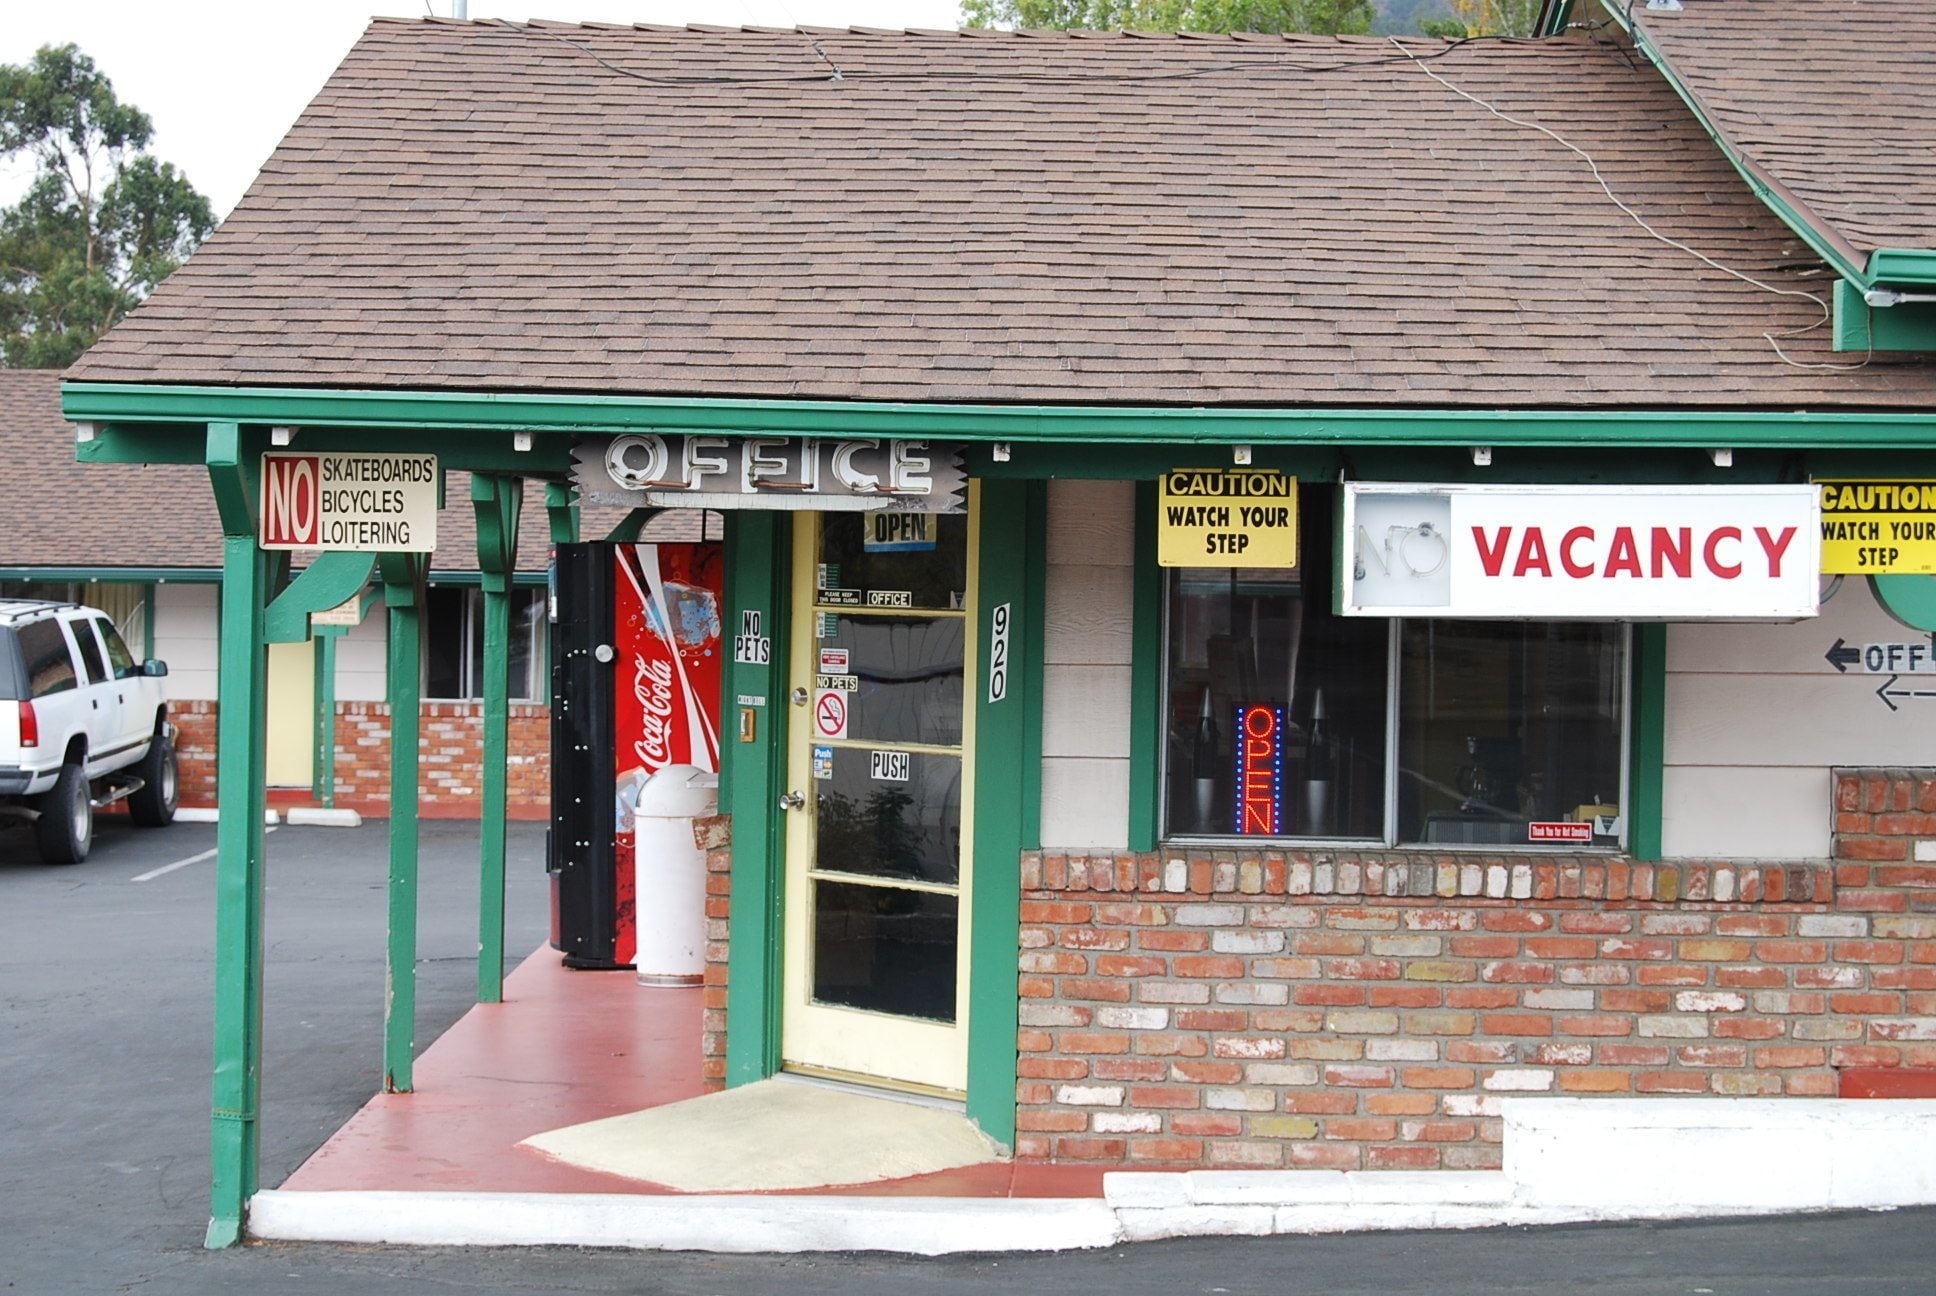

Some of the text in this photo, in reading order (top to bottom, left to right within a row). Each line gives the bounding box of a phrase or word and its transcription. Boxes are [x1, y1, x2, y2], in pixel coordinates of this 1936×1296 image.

[322, 456, 433, 483] SKATEBOARDS
[604, 434, 933, 495] OFFICE
[1169, 473, 1287, 496] CAUTION
[268, 458, 315, 543] NO
[322, 489, 404, 514] BICYCLES
[1821, 485, 1936, 510] CAUTION
[875, 512, 926, 543] OPEN
[1167, 506, 1289, 528] WATCH YOUR
[322, 520, 410, 545] LOITERING
[1206, 533, 1249, 554] STEP
[1821, 521, 1936, 541] WATCH YOUR
[1356, 524, 1799, 579] NO VACANCY
[1858, 547, 1899, 566] STEP
[871, 593, 908, 606] OFFICE
[743, 611, 760, 636] NO
[735, 637, 769, 663] PETS
[991, 606, 1008, 699] 920
[816, 676, 856, 690] NO PETS
[634, 652, 672, 769] Coca-Cola
[814, 748, 832, 758] Push
[872, 752, 908, 779] PUSH
[1245, 708, 1274, 834] OPEN
